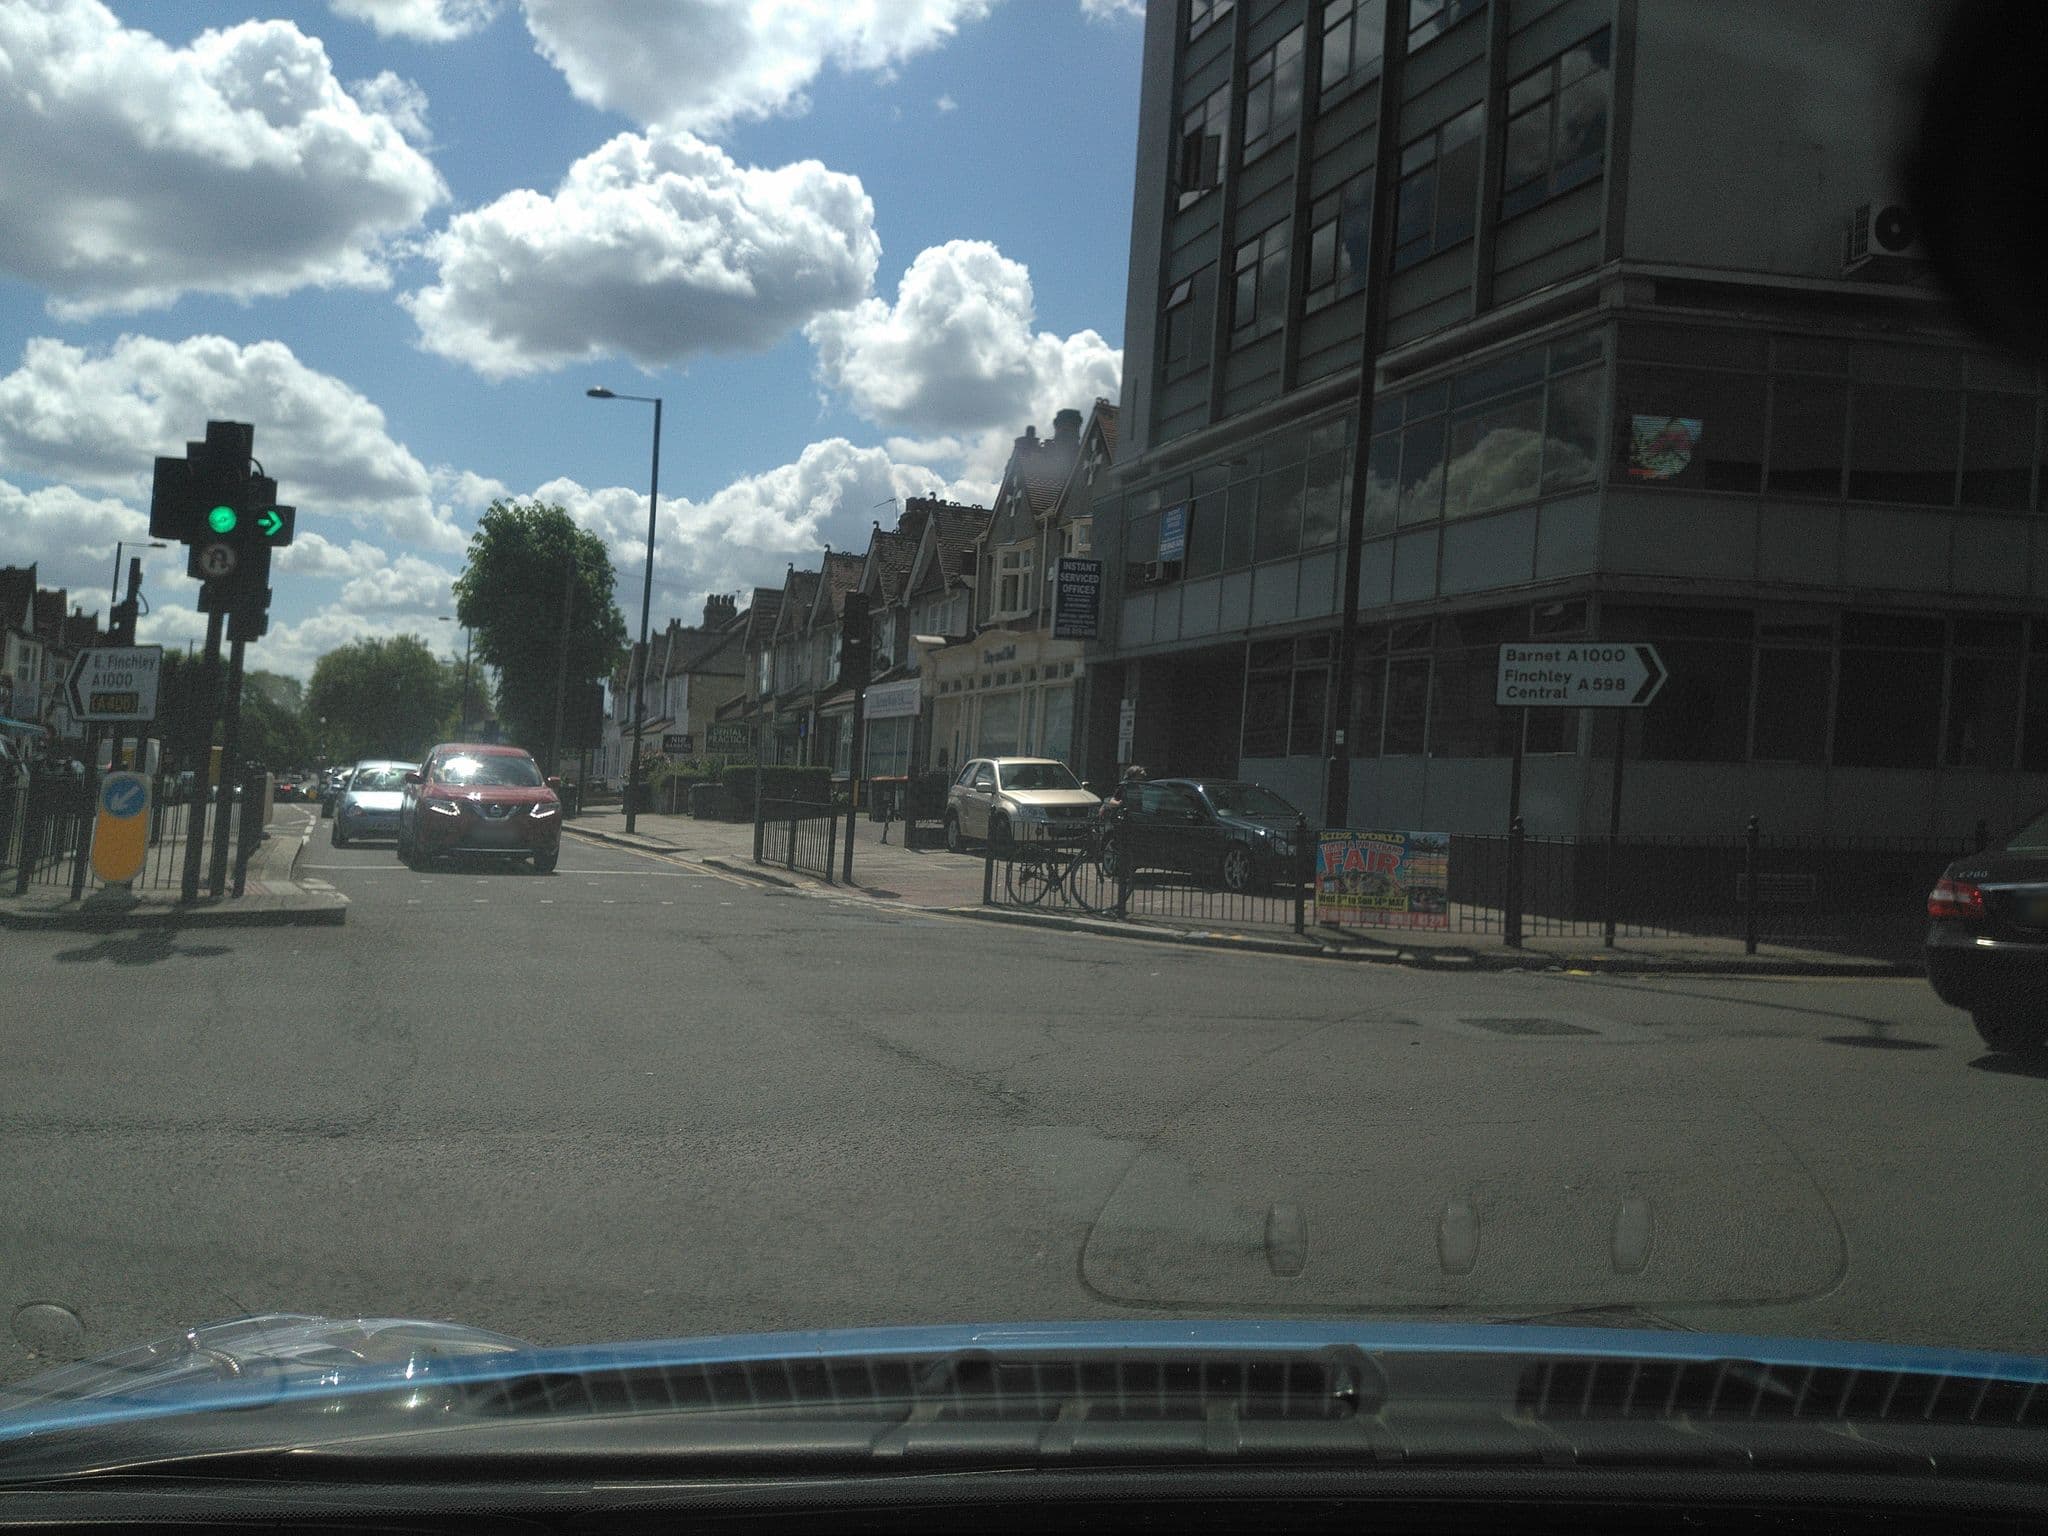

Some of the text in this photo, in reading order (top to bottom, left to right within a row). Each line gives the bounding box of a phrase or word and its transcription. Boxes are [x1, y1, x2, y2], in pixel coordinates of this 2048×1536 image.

[1063, 561, 1098, 572] INSTANT
[1060, 572, 1099, 583] SERVICED
[1062, 584, 1096, 594] OFFICES
[108, 653, 156, 671] Finchley
[1506, 649, 1626, 662] Barnet A1000
[92, 671, 133, 688] A1000
[1504, 669, 1572, 684] Finchley
[1578, 678, 1626, 691] A598
[1506, 686, 1568, 699] Central
[713, 727, 742, 736] DENTAL
[708, 735, 747, 744] PRACTICE
[1320, 831, 1405, 844] KIDZ WORLD
[1322, 848, 1400, 879] FAIR
